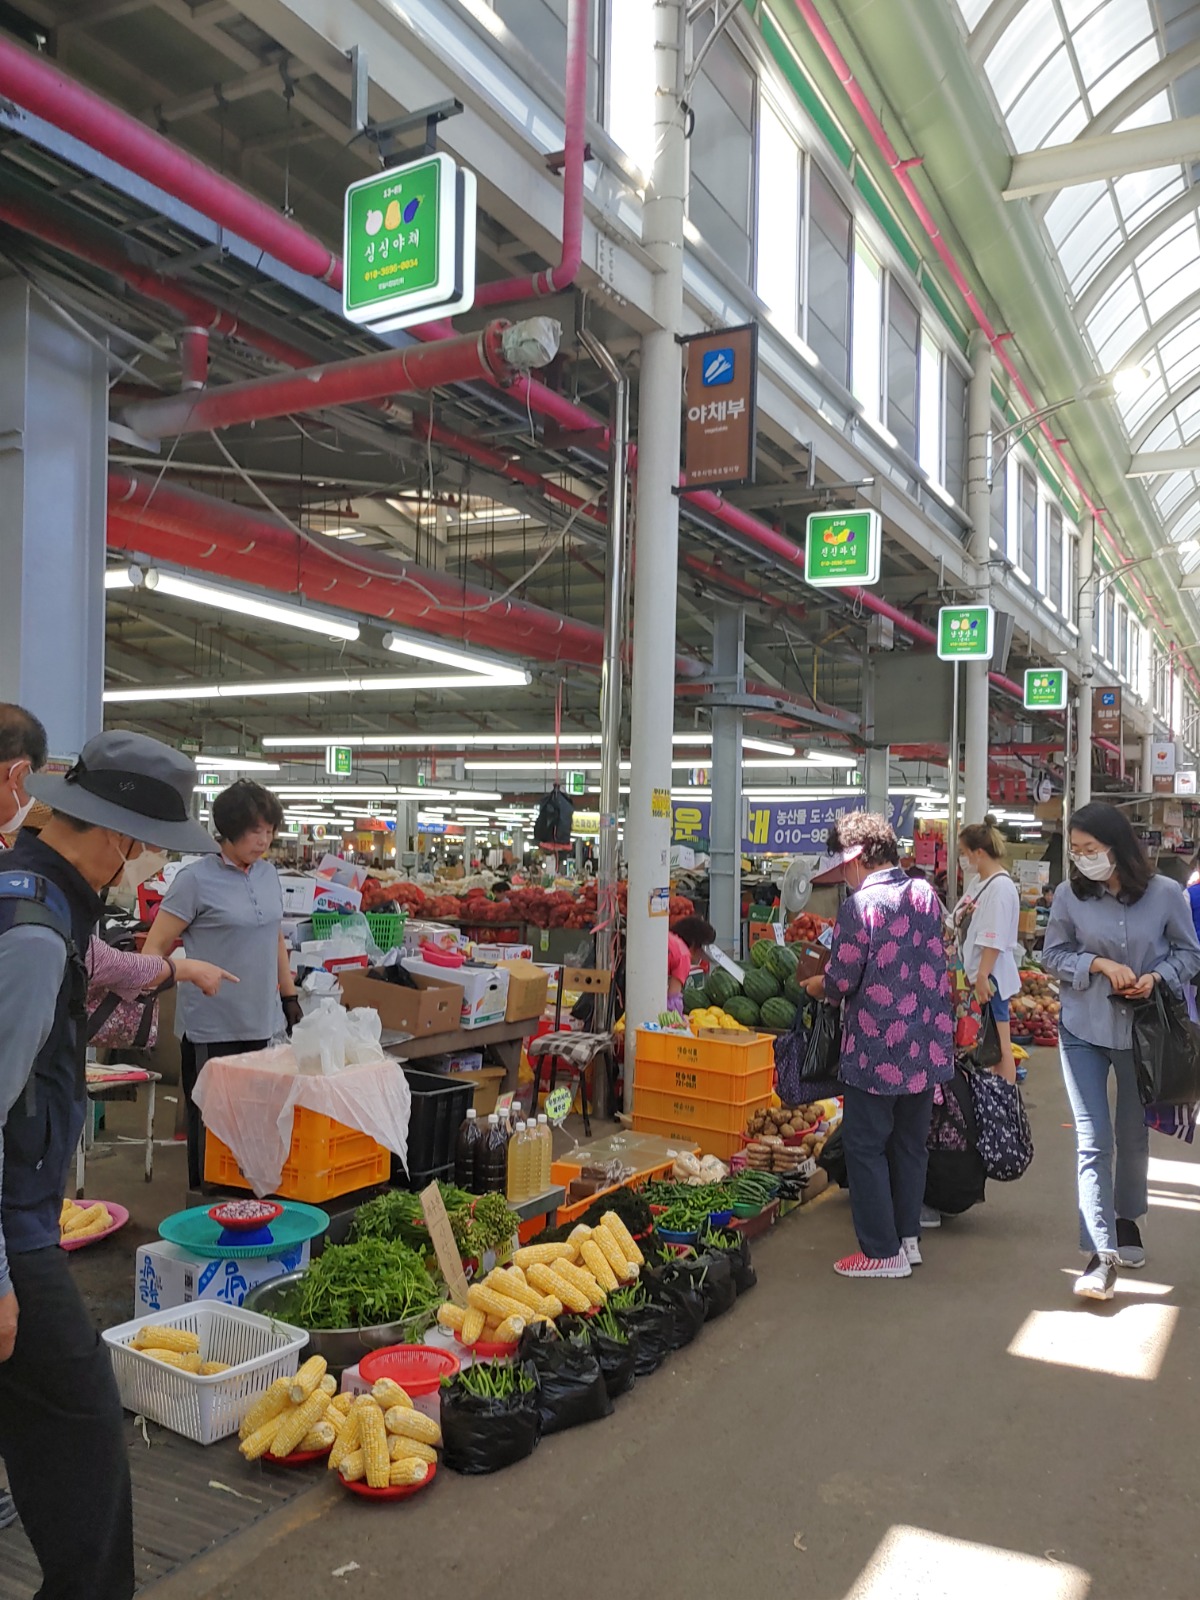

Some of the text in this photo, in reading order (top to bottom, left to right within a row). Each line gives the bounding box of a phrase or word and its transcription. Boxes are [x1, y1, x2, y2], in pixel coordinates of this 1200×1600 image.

[364, 228, 419, 263] 싱싱야채
[688, 398, 746, 424] 야채부
[776, 808, 807, 826] 농산물
[774, 827, 830, 844] 010-98
